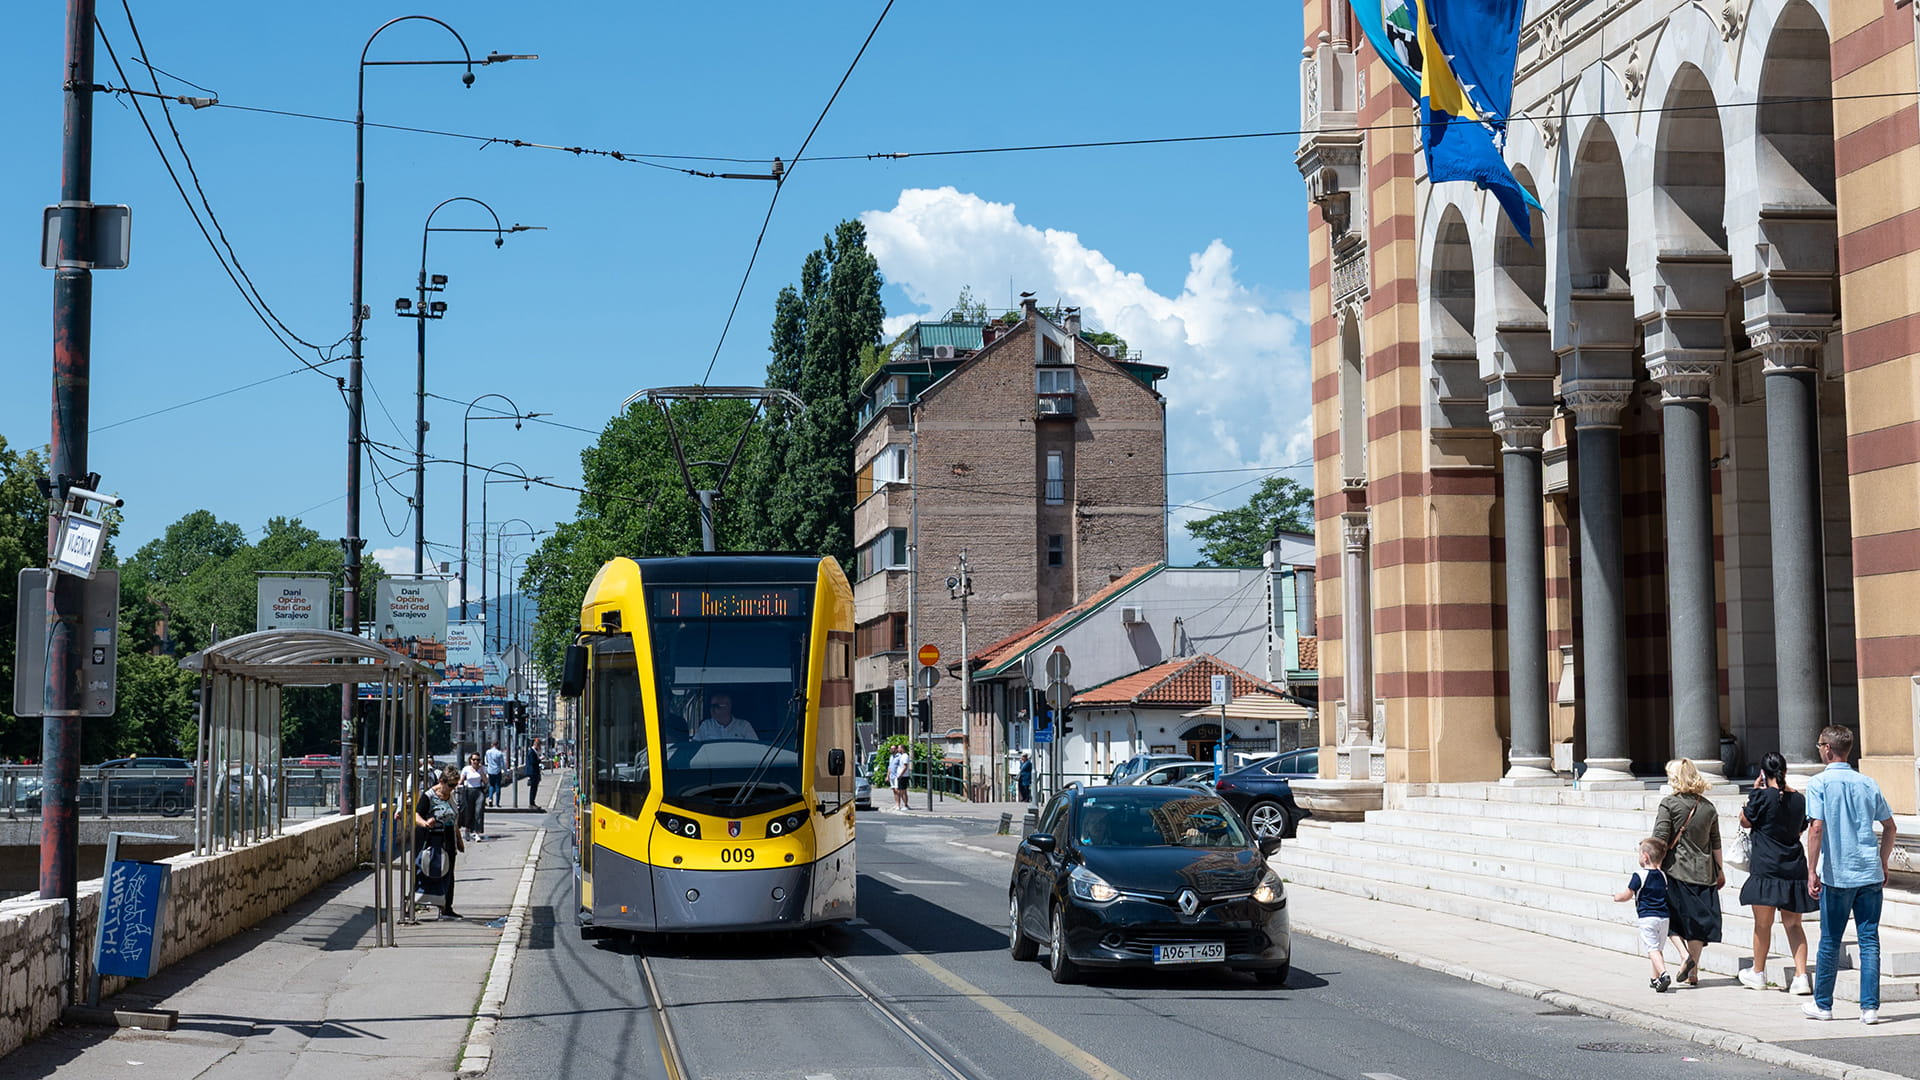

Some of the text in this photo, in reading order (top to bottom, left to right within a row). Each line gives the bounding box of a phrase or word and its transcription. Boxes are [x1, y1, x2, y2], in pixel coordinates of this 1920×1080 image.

[283, 588, 302, 596] Dani
[410, 603, 430, 611] Grad
[275, 611, 309, 620] Sarajevo
[392, 611, 427, 620] Sarajevo
[720, 848, 755, 863] 009
[1162, 944, 1223, 960] A96-T-459
